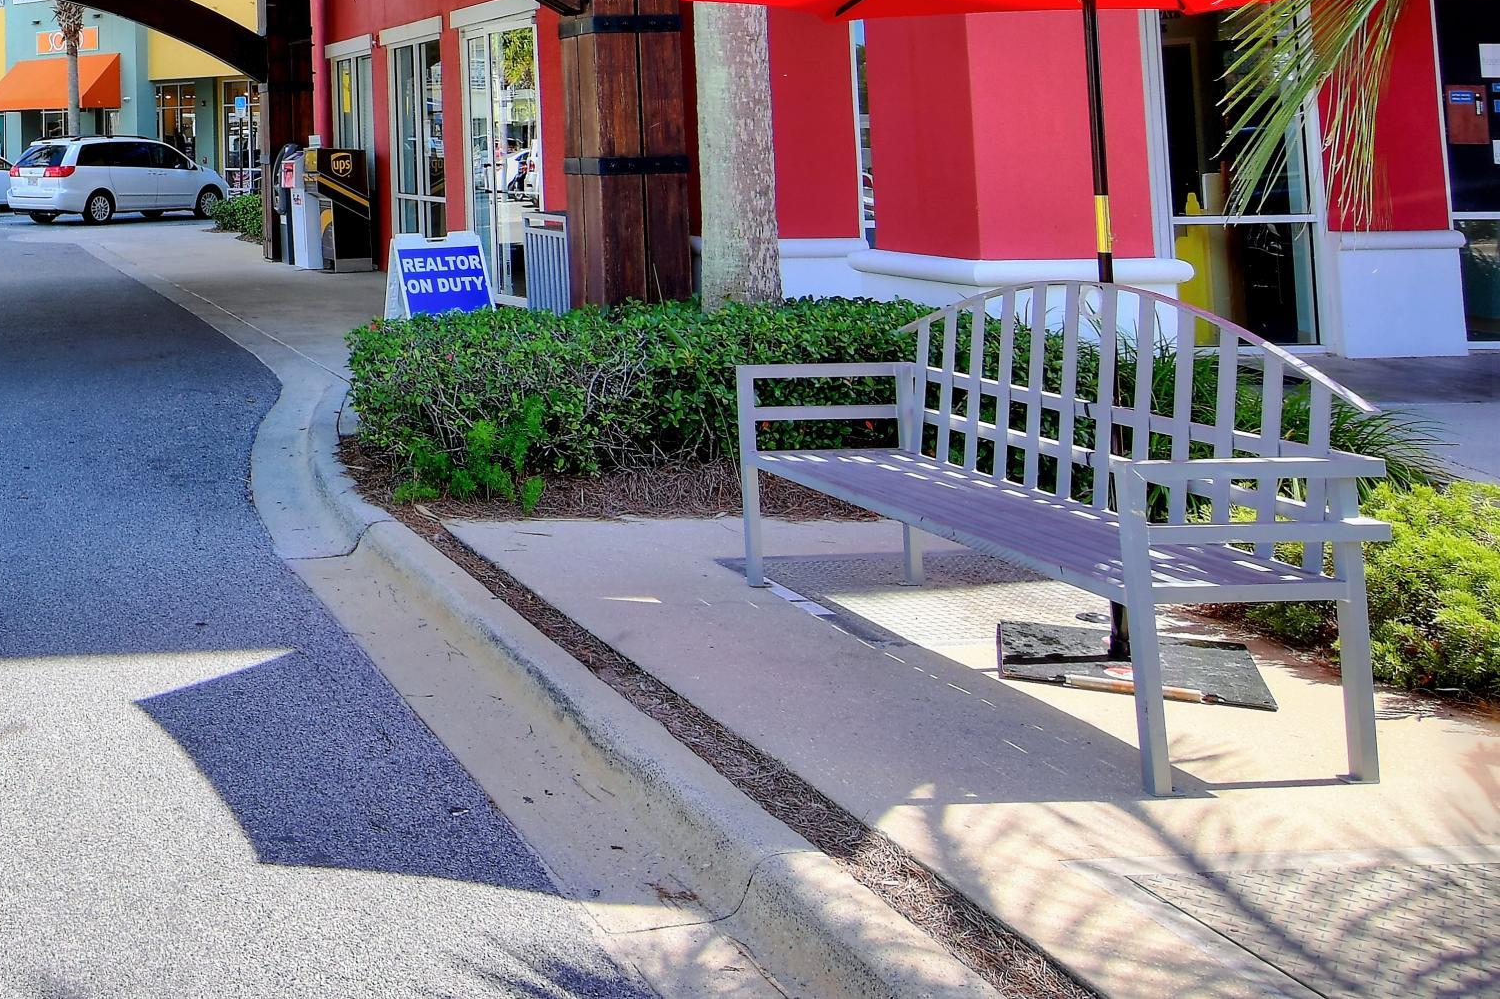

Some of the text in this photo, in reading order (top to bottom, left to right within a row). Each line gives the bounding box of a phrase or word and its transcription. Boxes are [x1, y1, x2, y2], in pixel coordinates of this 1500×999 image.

[333, 160, 351, 173] ups
[402, 255, 482, 273] REALTOR
[407, 276, 484, 294] ON DUTY
